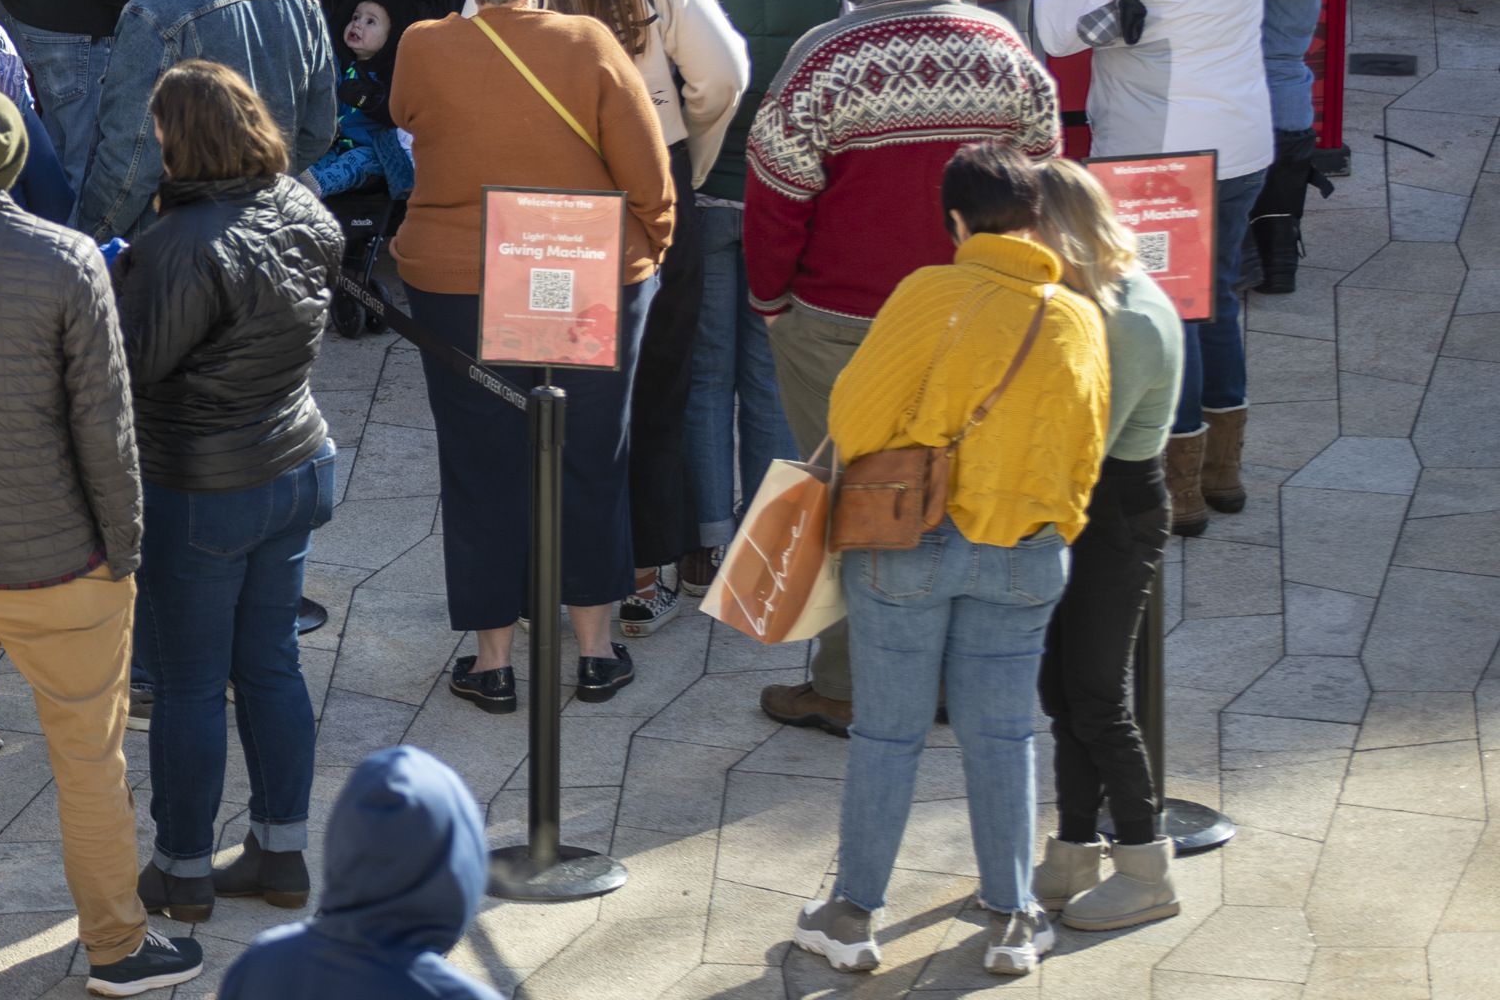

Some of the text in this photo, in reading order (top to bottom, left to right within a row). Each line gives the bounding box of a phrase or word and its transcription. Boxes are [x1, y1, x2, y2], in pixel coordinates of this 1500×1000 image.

[516, 197, 593, 209] Welcome to the
[1119, 196, 1178, 209] LightWorld
[1142, 207, 1198, 221] Machine
[498, 243, 606, 261] Giving Machine
[361, 290, 385, 316] CENTER
[469, 365, 527, 412] CITY CREEK CENTER
